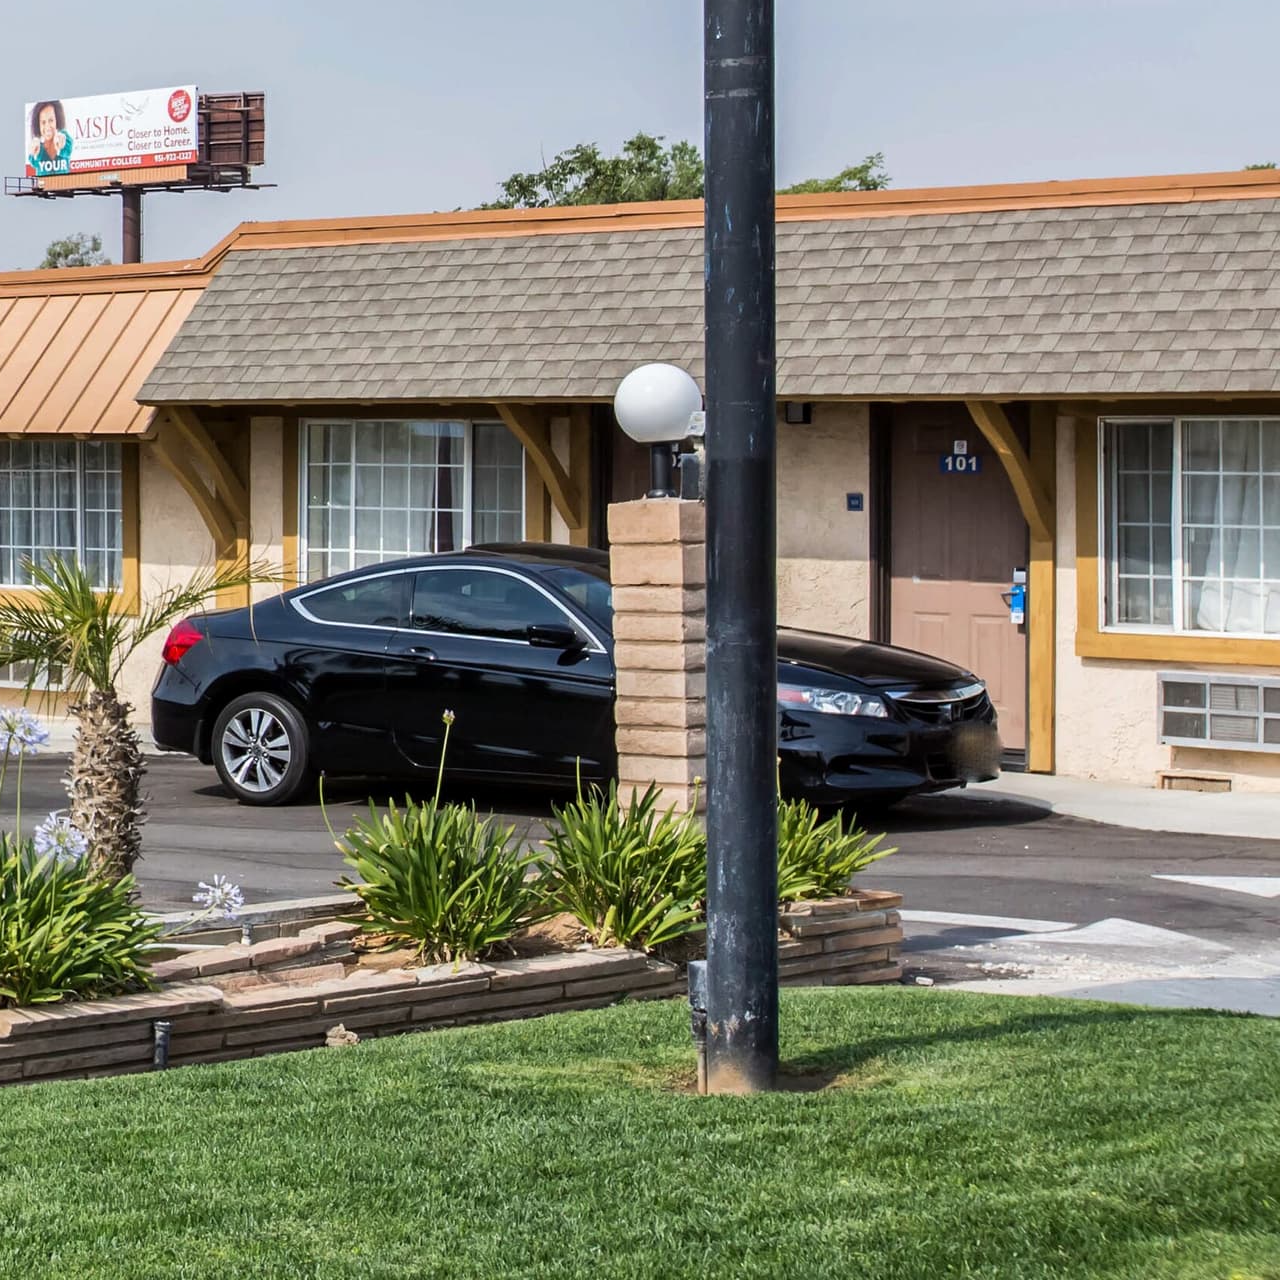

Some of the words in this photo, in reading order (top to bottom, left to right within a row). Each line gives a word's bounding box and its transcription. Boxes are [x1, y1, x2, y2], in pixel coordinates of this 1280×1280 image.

[75, 115, 123, 140] MSJC
[128, 129, 152, 139] Closer
[153, 129, 162, 137] to
[163, 126, 190, 136] Home.
[128, 141, 152, 151] Closer
[153, 140, 162, 149] to
[163, 137, 192, 148] Career.
[38, 160, 68, 172] YOUR
[70, 160, 110, 169] COMMUNITY
[111, 156, 142, 166] COLLEGE
[945, 456, 977, 471] 101
